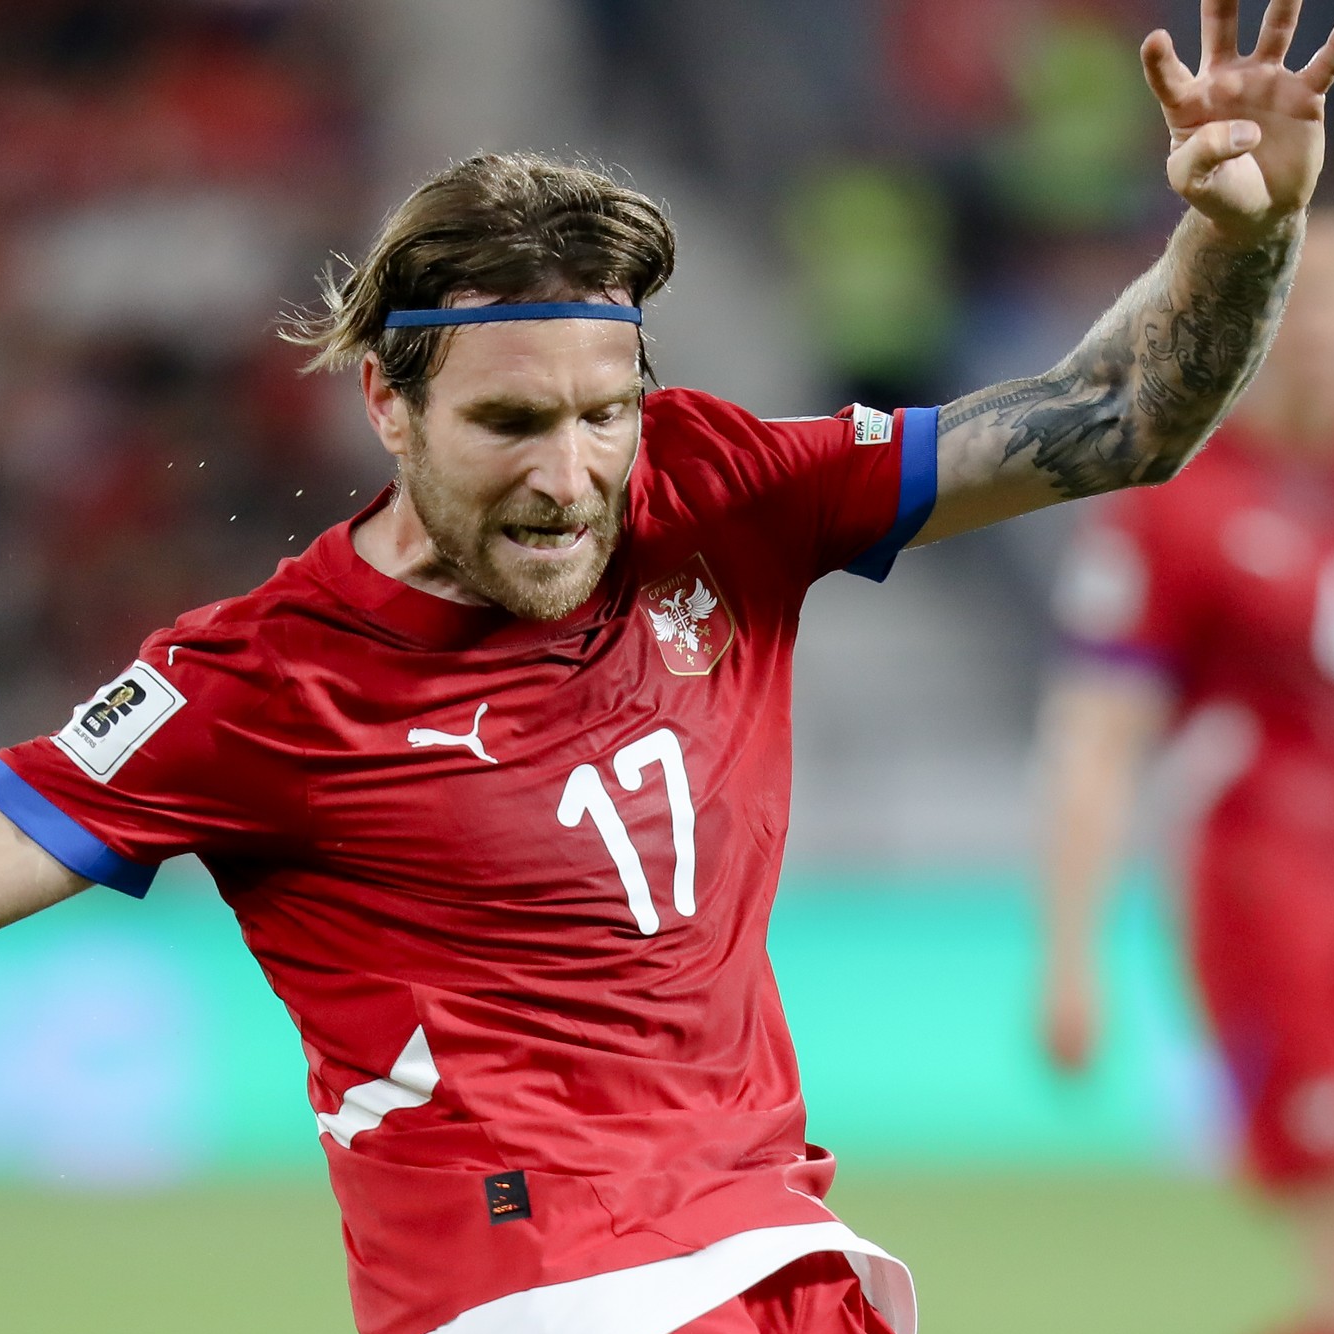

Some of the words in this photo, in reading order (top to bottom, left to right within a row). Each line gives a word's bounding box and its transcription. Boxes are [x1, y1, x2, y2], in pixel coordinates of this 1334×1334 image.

[856, 421, 865, 441] UEFA
[86, 716, 102, 732] FIFA
[556, 727, 697, 936] 17
